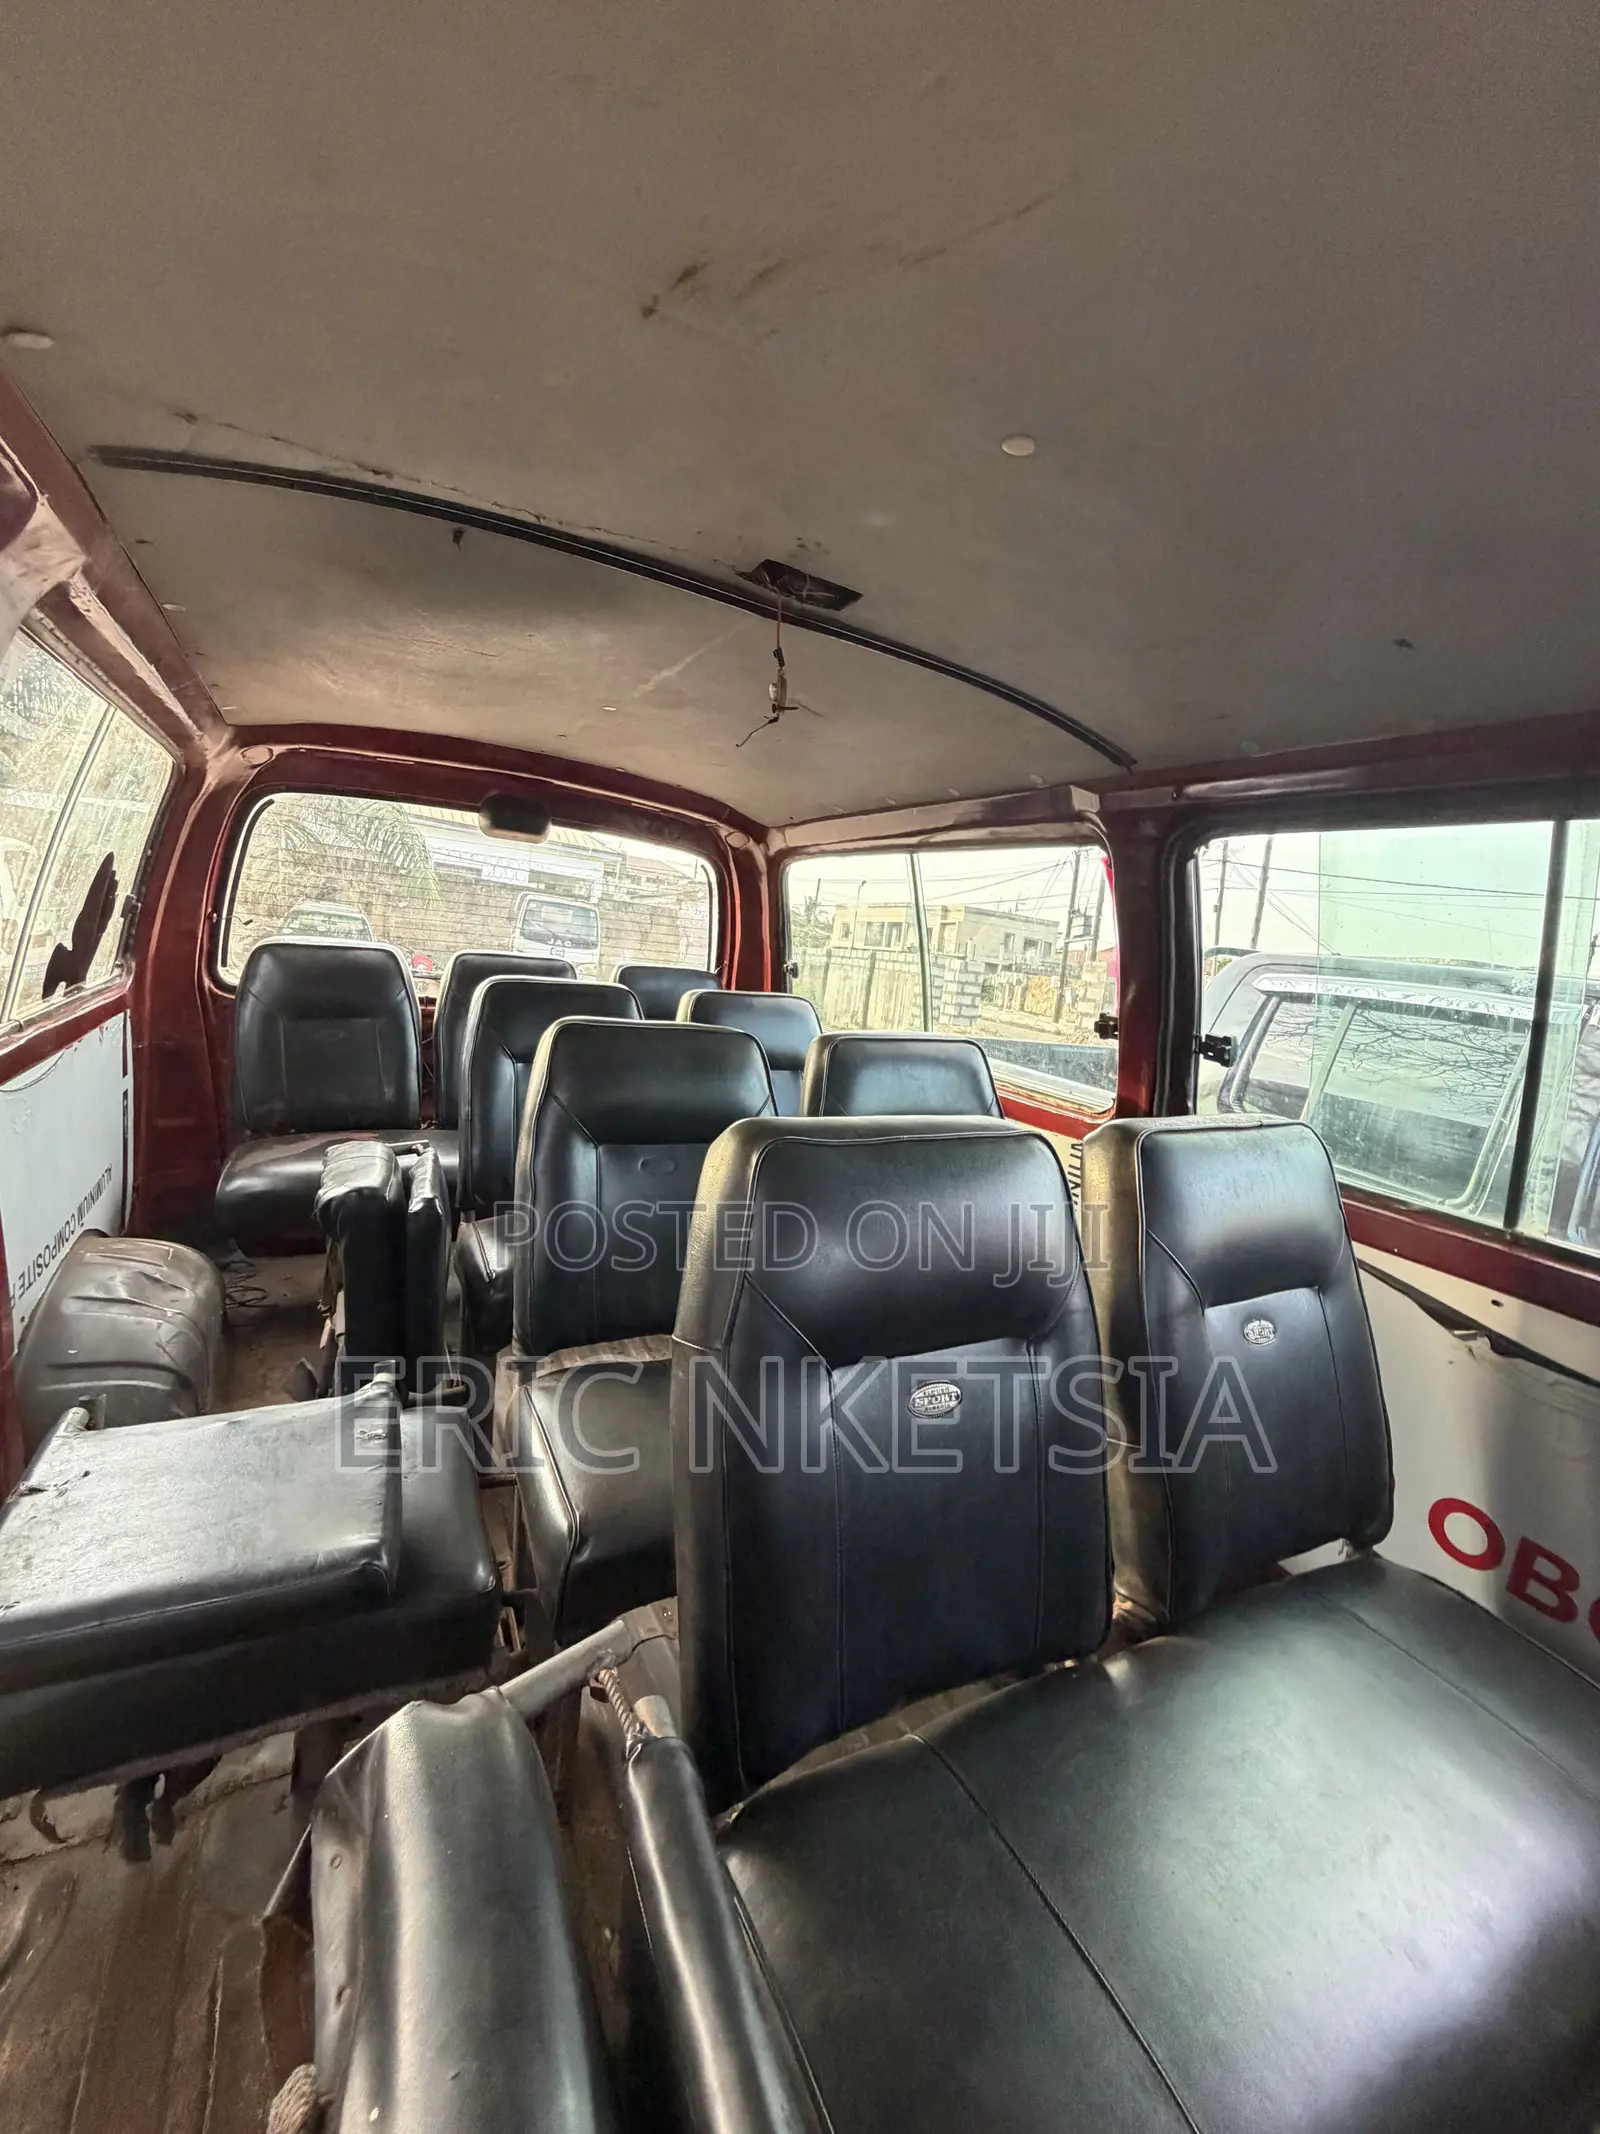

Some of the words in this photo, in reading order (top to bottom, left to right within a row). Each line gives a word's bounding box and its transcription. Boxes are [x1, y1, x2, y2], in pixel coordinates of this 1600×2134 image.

[76, 1162, 113, 1226] ALUMINIUM
[18, 1213, 76, 1299] COMPOSITE
[914, 1391, 959, 1408] SPORT
[1428, 1497, 1600, 1647] OB
